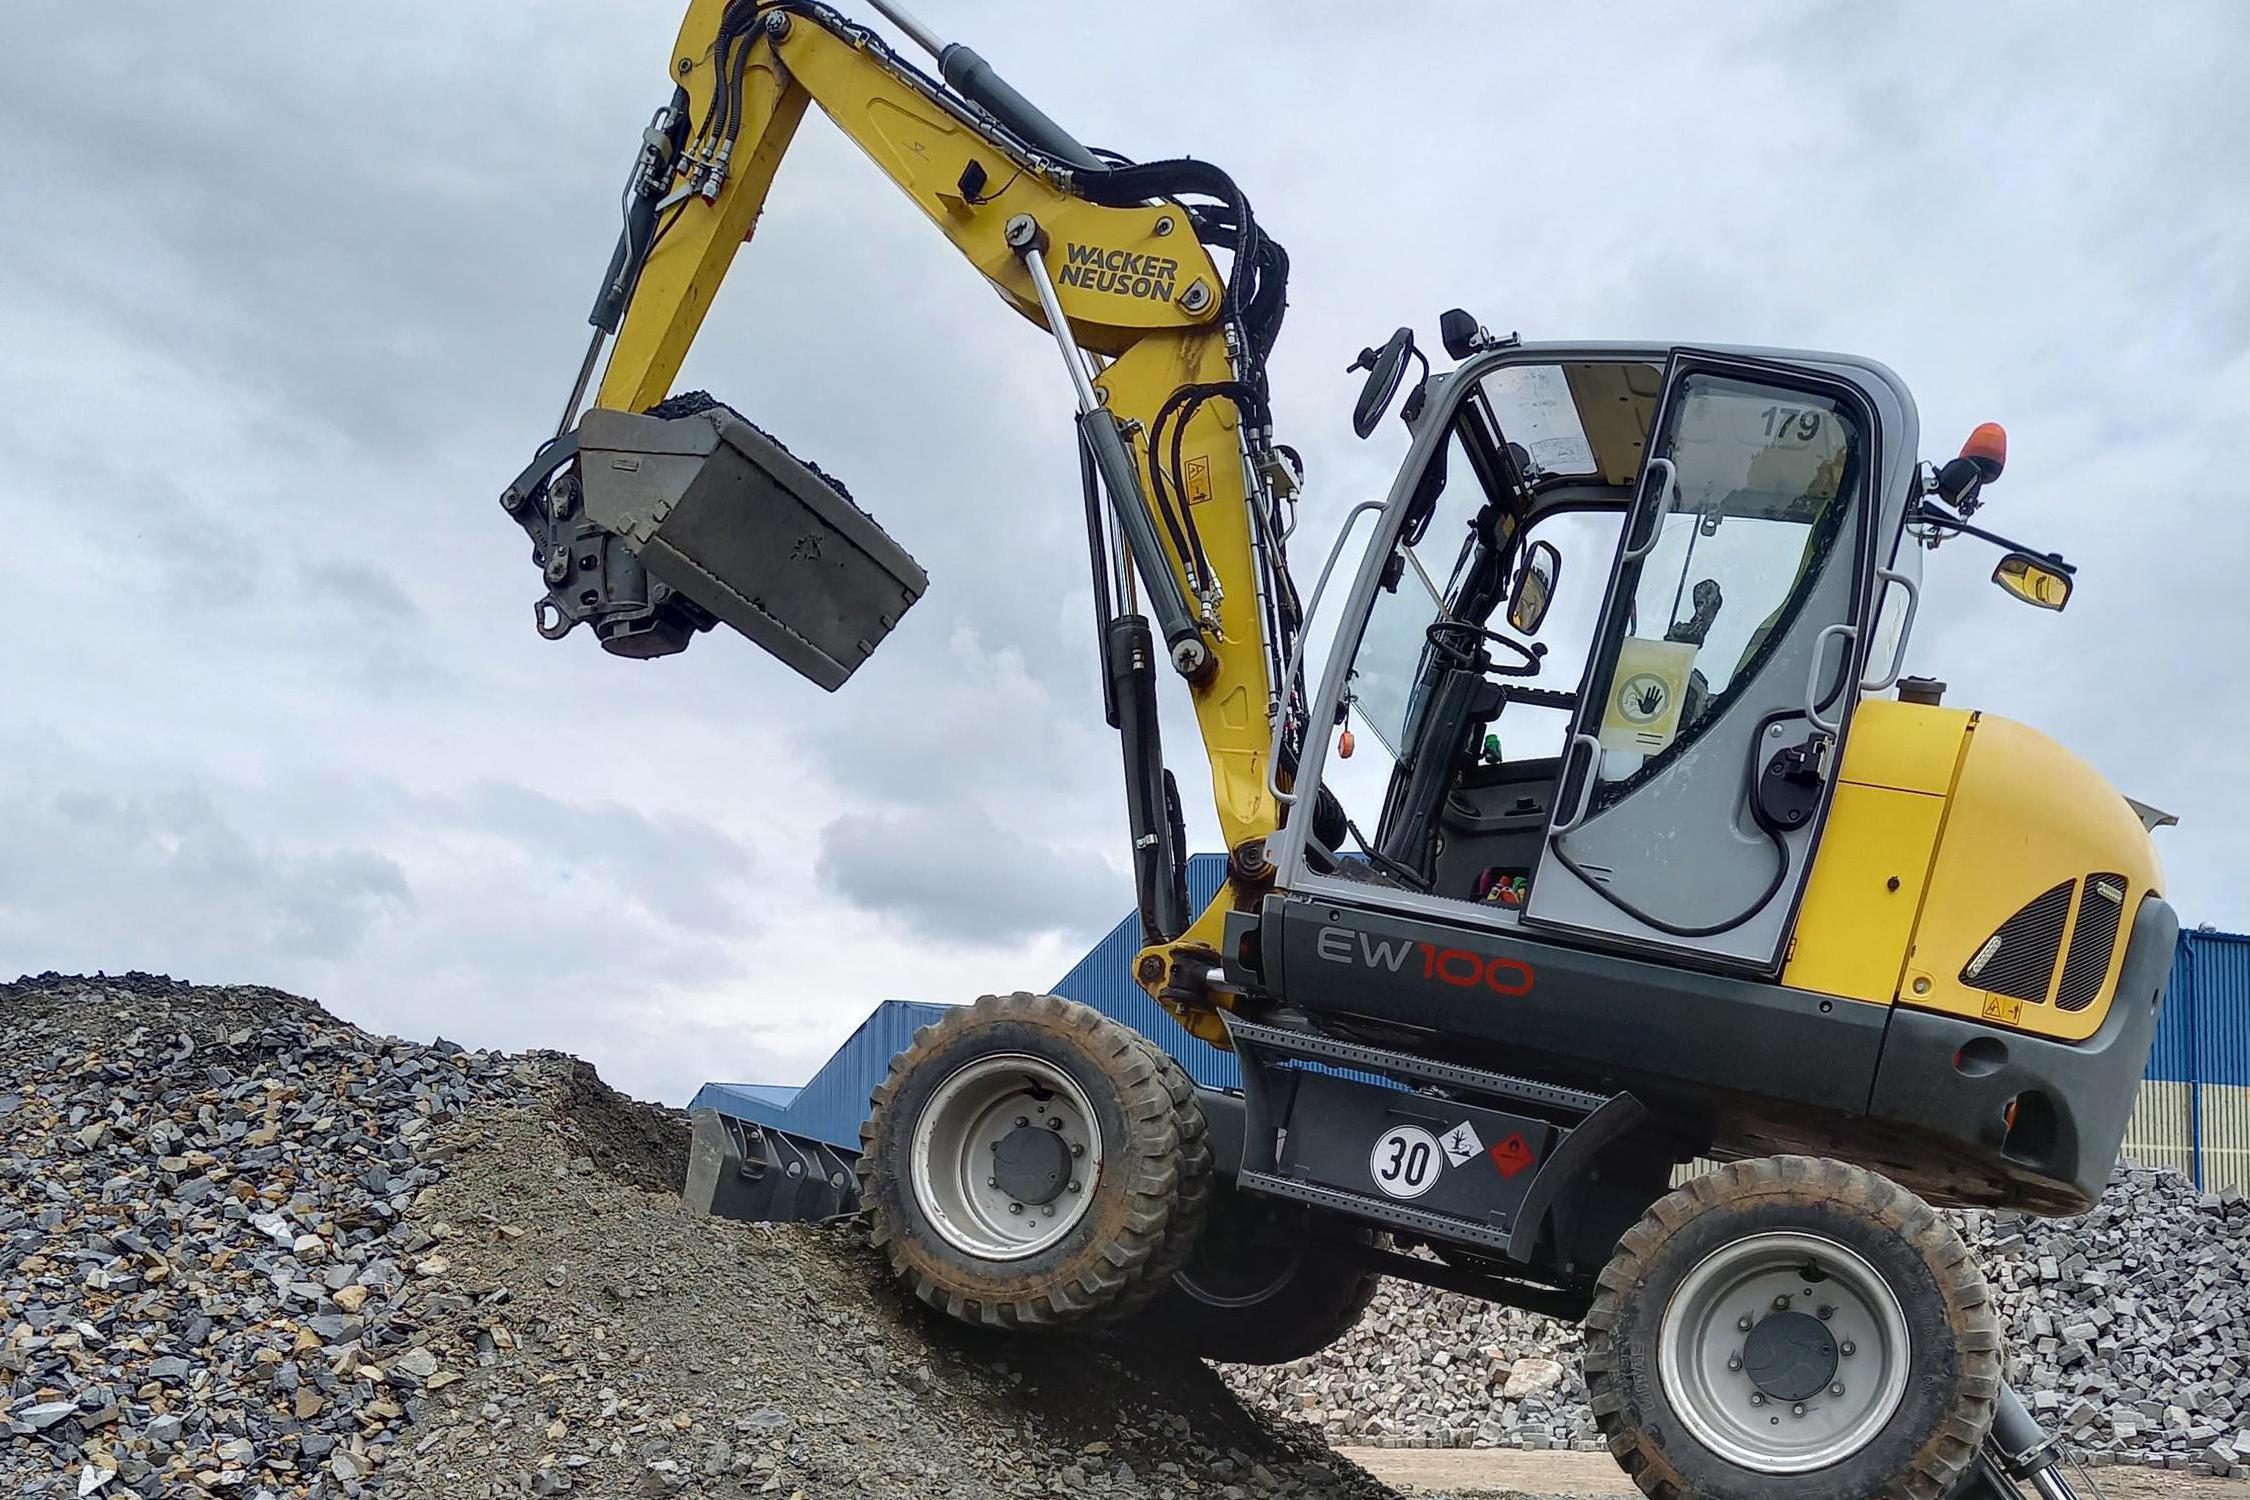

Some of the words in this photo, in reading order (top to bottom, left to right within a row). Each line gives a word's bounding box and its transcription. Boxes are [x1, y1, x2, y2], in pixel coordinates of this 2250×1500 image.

[1067, 242, 1178, 280] WACKER
[1058, 264, 1176, 303] NEUSON
[1761, 406, 1820, 441] 179
[1317, 926, 1535, 997] EW100
[1381, 1136, 1431, 1186] 30
